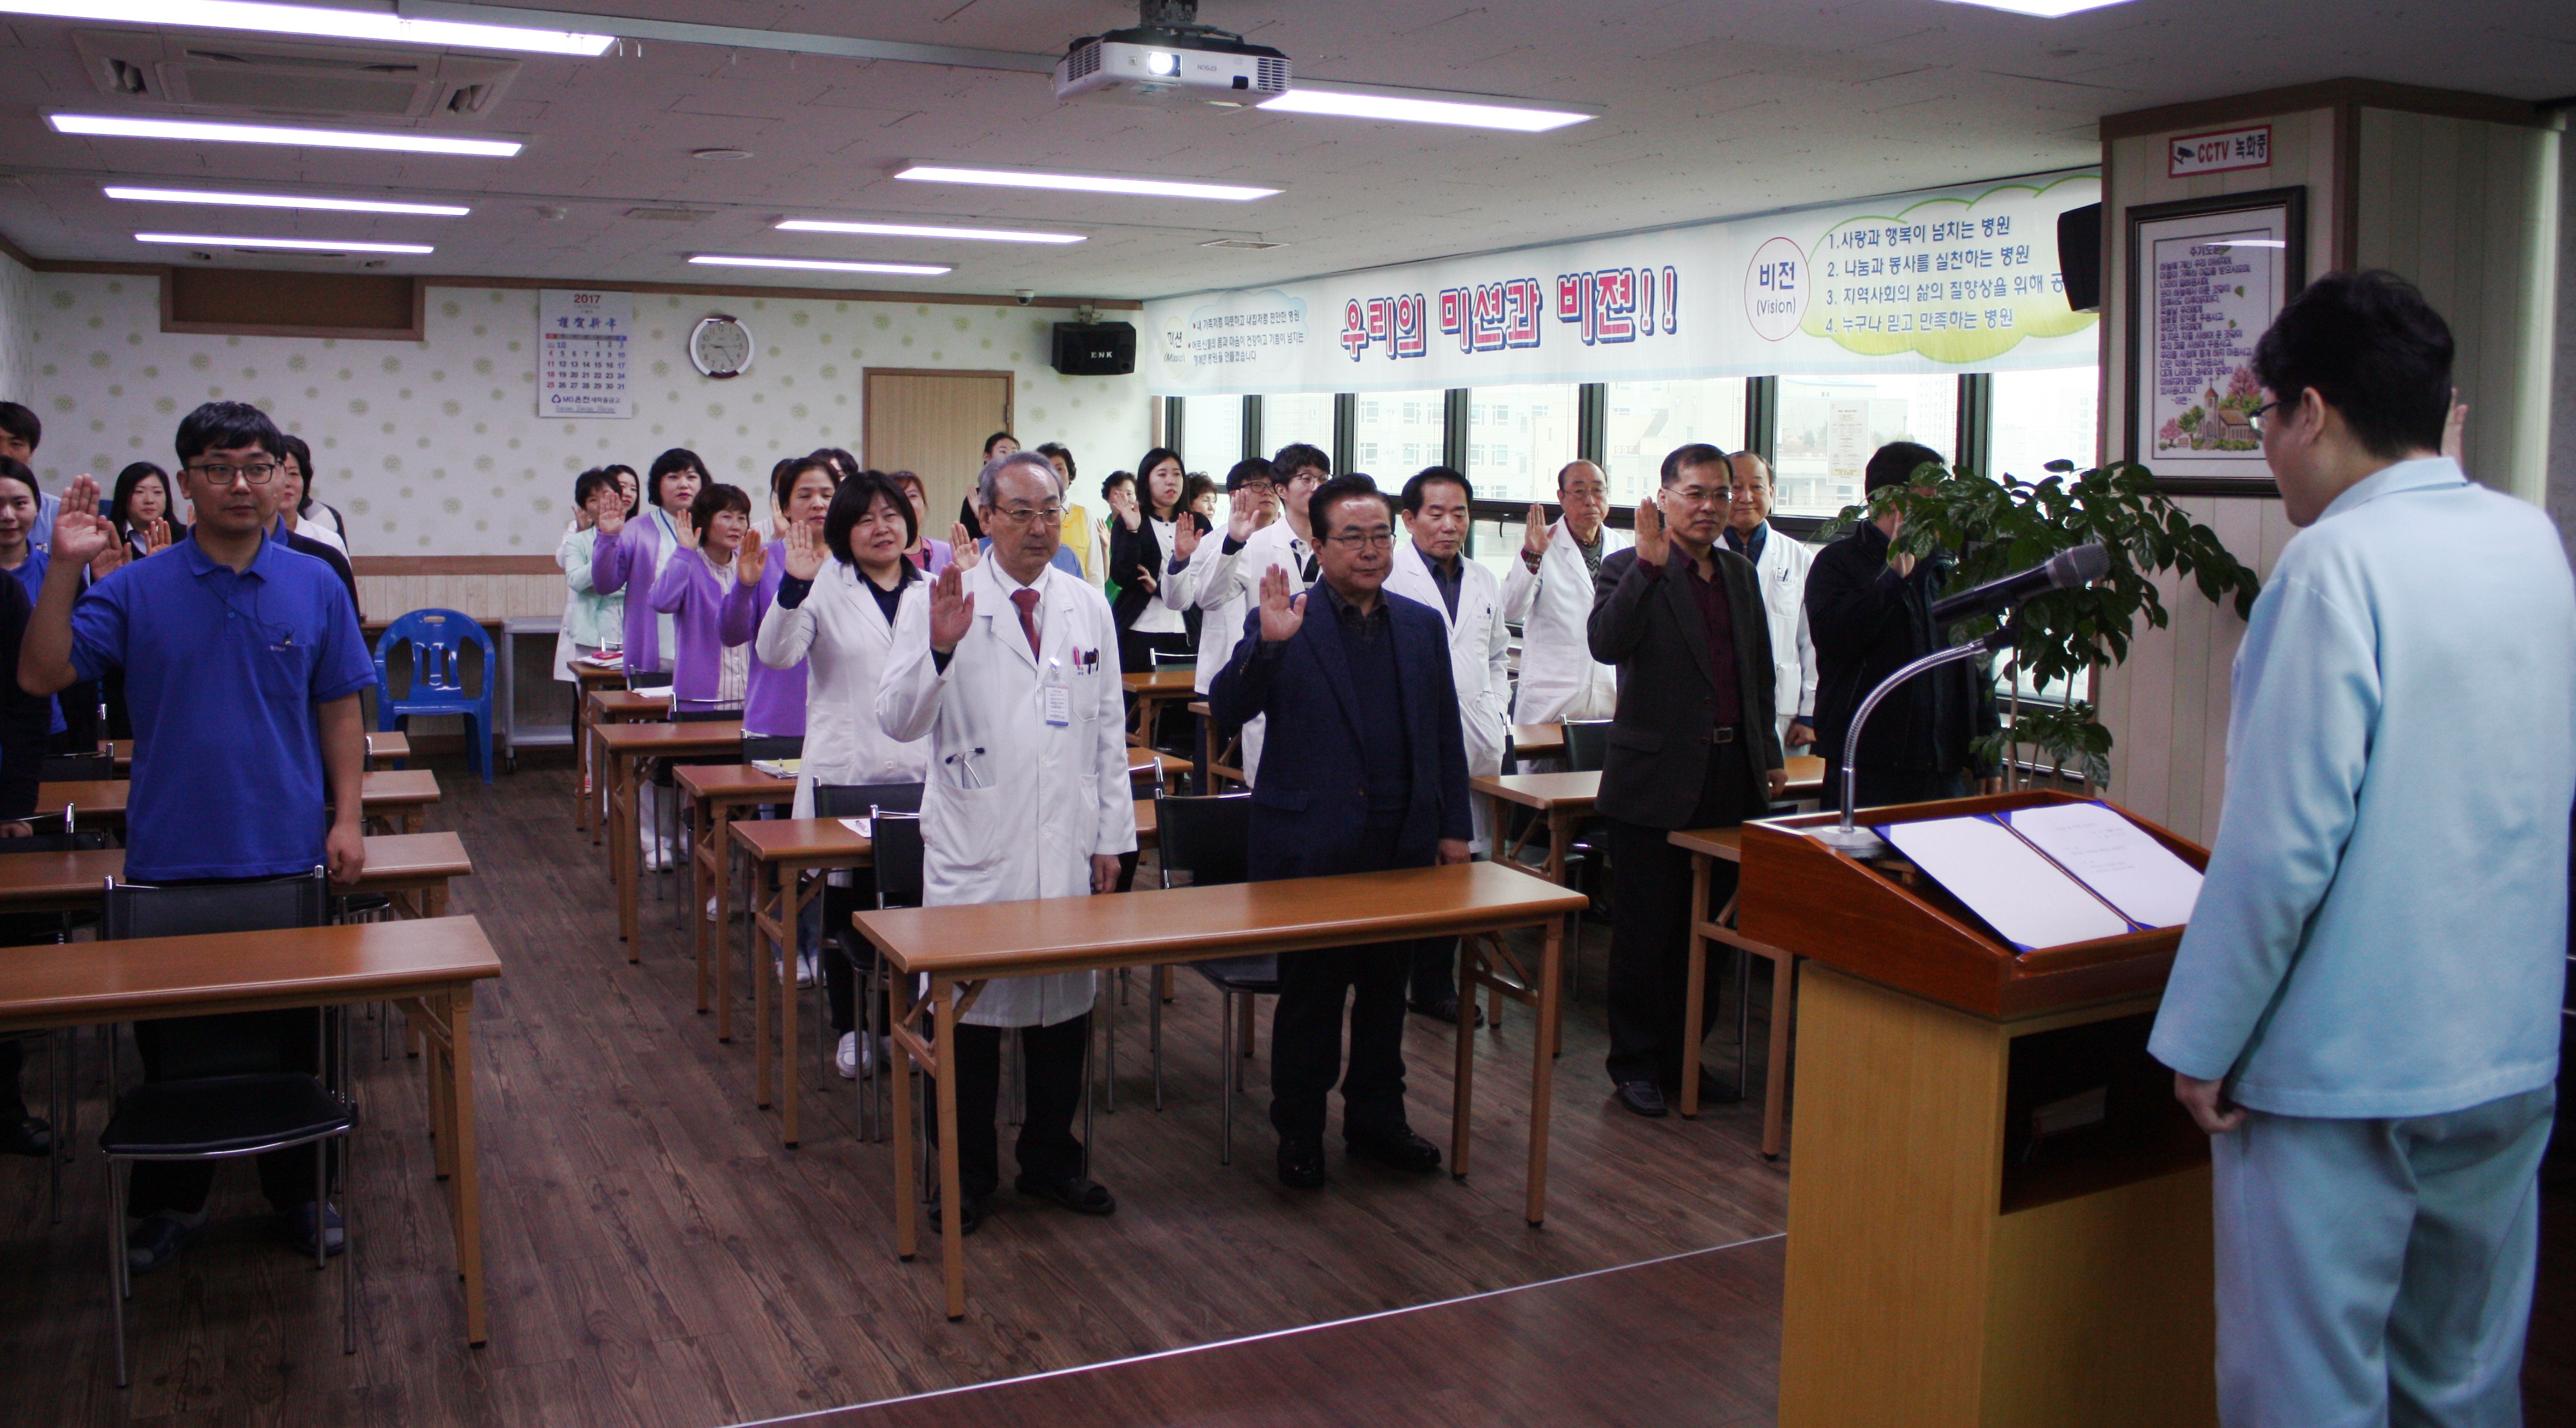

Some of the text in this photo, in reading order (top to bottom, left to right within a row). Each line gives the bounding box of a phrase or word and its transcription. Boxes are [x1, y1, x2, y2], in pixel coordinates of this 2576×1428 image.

[2197, 134, 2266, 163] CCTV 녹화중
[1886, 224, 1926, 245] 행복이
[1932, 220, 1974, 241] 넘치는
[1982, 215, 2010, 237] 병원
[1760, 261, 1795, 291] 비전
[1845, 256, 1883, 279] 나눔과
[1889, 251, 1929, 274] 봉사를
[1935, 248, 1992, 271] 실천하는
[2000, 244, 2030, 267] 병원
[573, 294, 601, 304] 2017
[1843, 282, 1910, 306] 지역사회의
[1916, 280, 1943, 302] 삶의
[1949, 277, 2007, 301] 질향상을
[2013, 273, 2044, 295] 위해
[1340, 265, 1677, 362] 우리의 미션과 비젼!!
[1757, 297, 1796, 317] (Vision)
[1842, 313, 1881, 335] 누구나
[1887, 311, 1913, 333] 믿고
[1920, 308, 1978, 332] 만족하는
[1984, 307, 2013, 329] 병원
[1167, 331, 1182, 349] 미션
